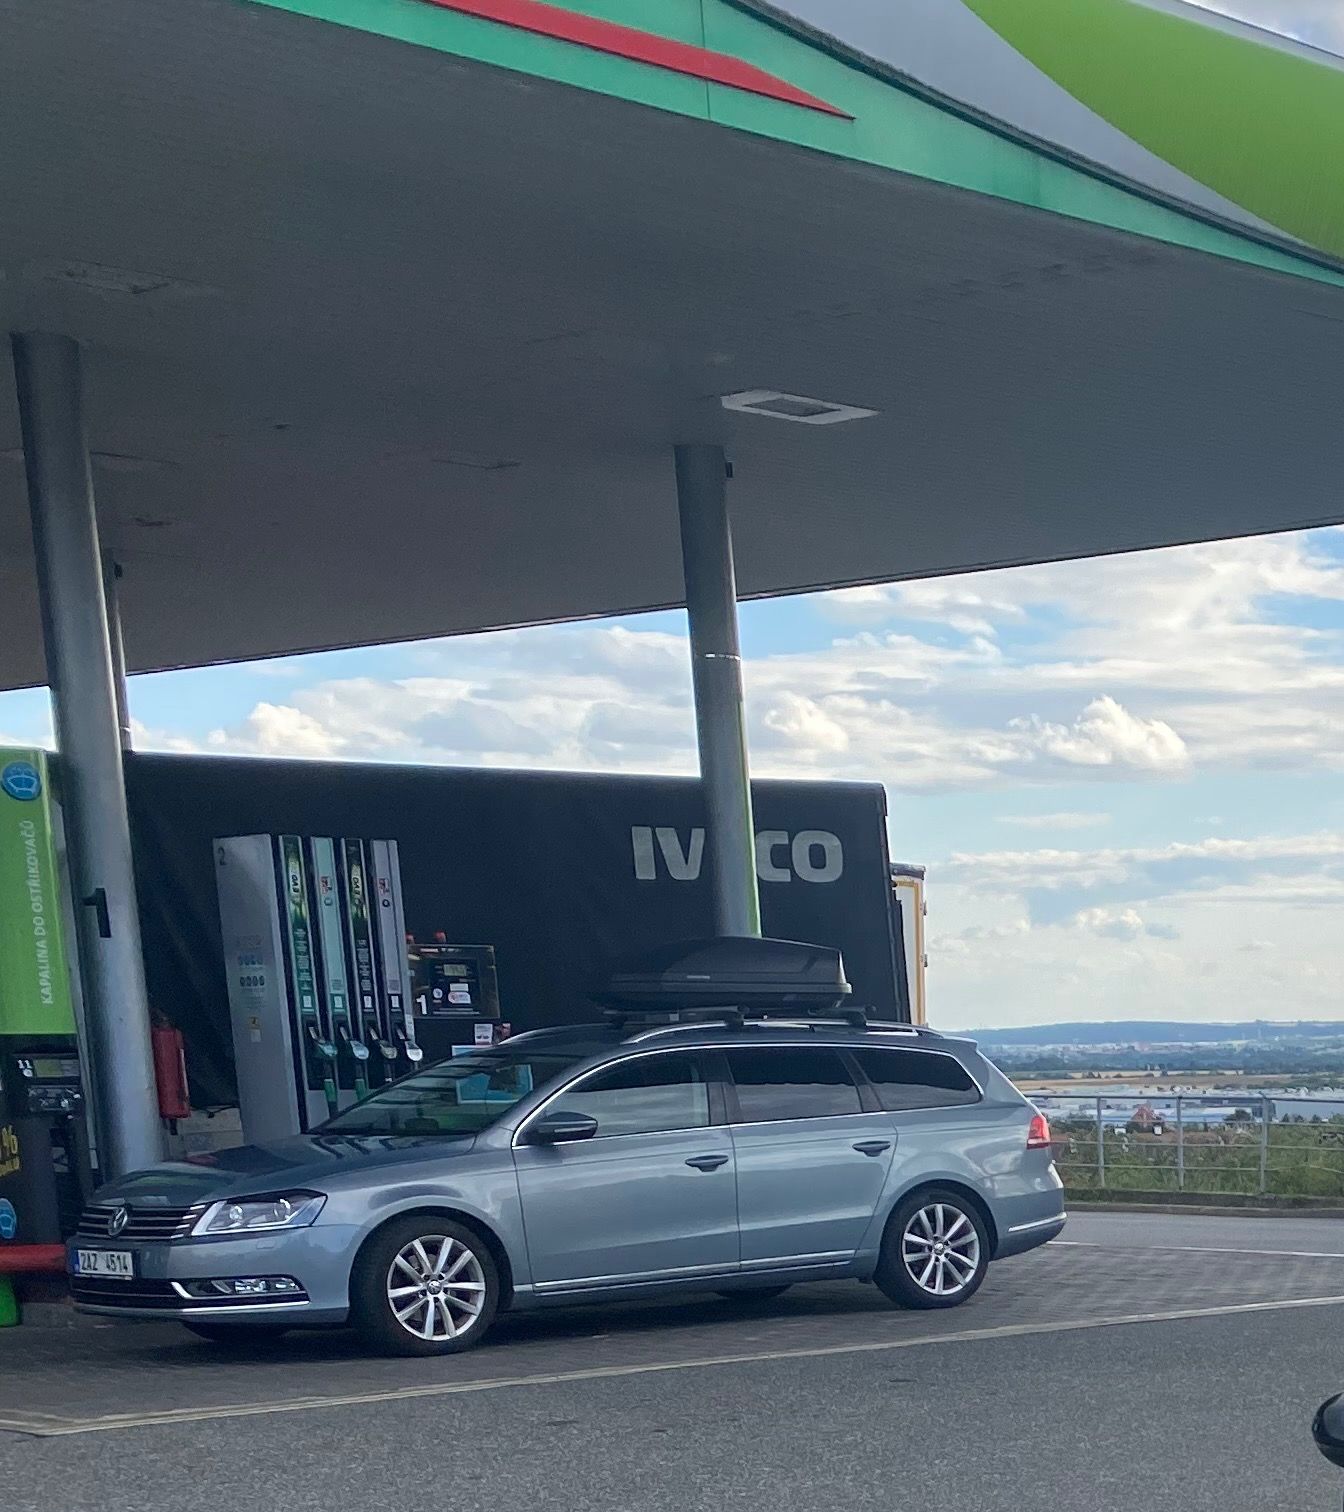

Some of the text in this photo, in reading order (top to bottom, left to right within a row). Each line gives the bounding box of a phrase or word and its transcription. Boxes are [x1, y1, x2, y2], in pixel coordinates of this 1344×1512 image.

[217, 847, 227, 866] 2
[631, 825, 844, 883] IVCO
[32, 914, 47, 937] DO
[81, 887, 112, 938] 1
[34, 939, 54, 1005] KAPALINA
[416, 994, 428, 1015] 1
